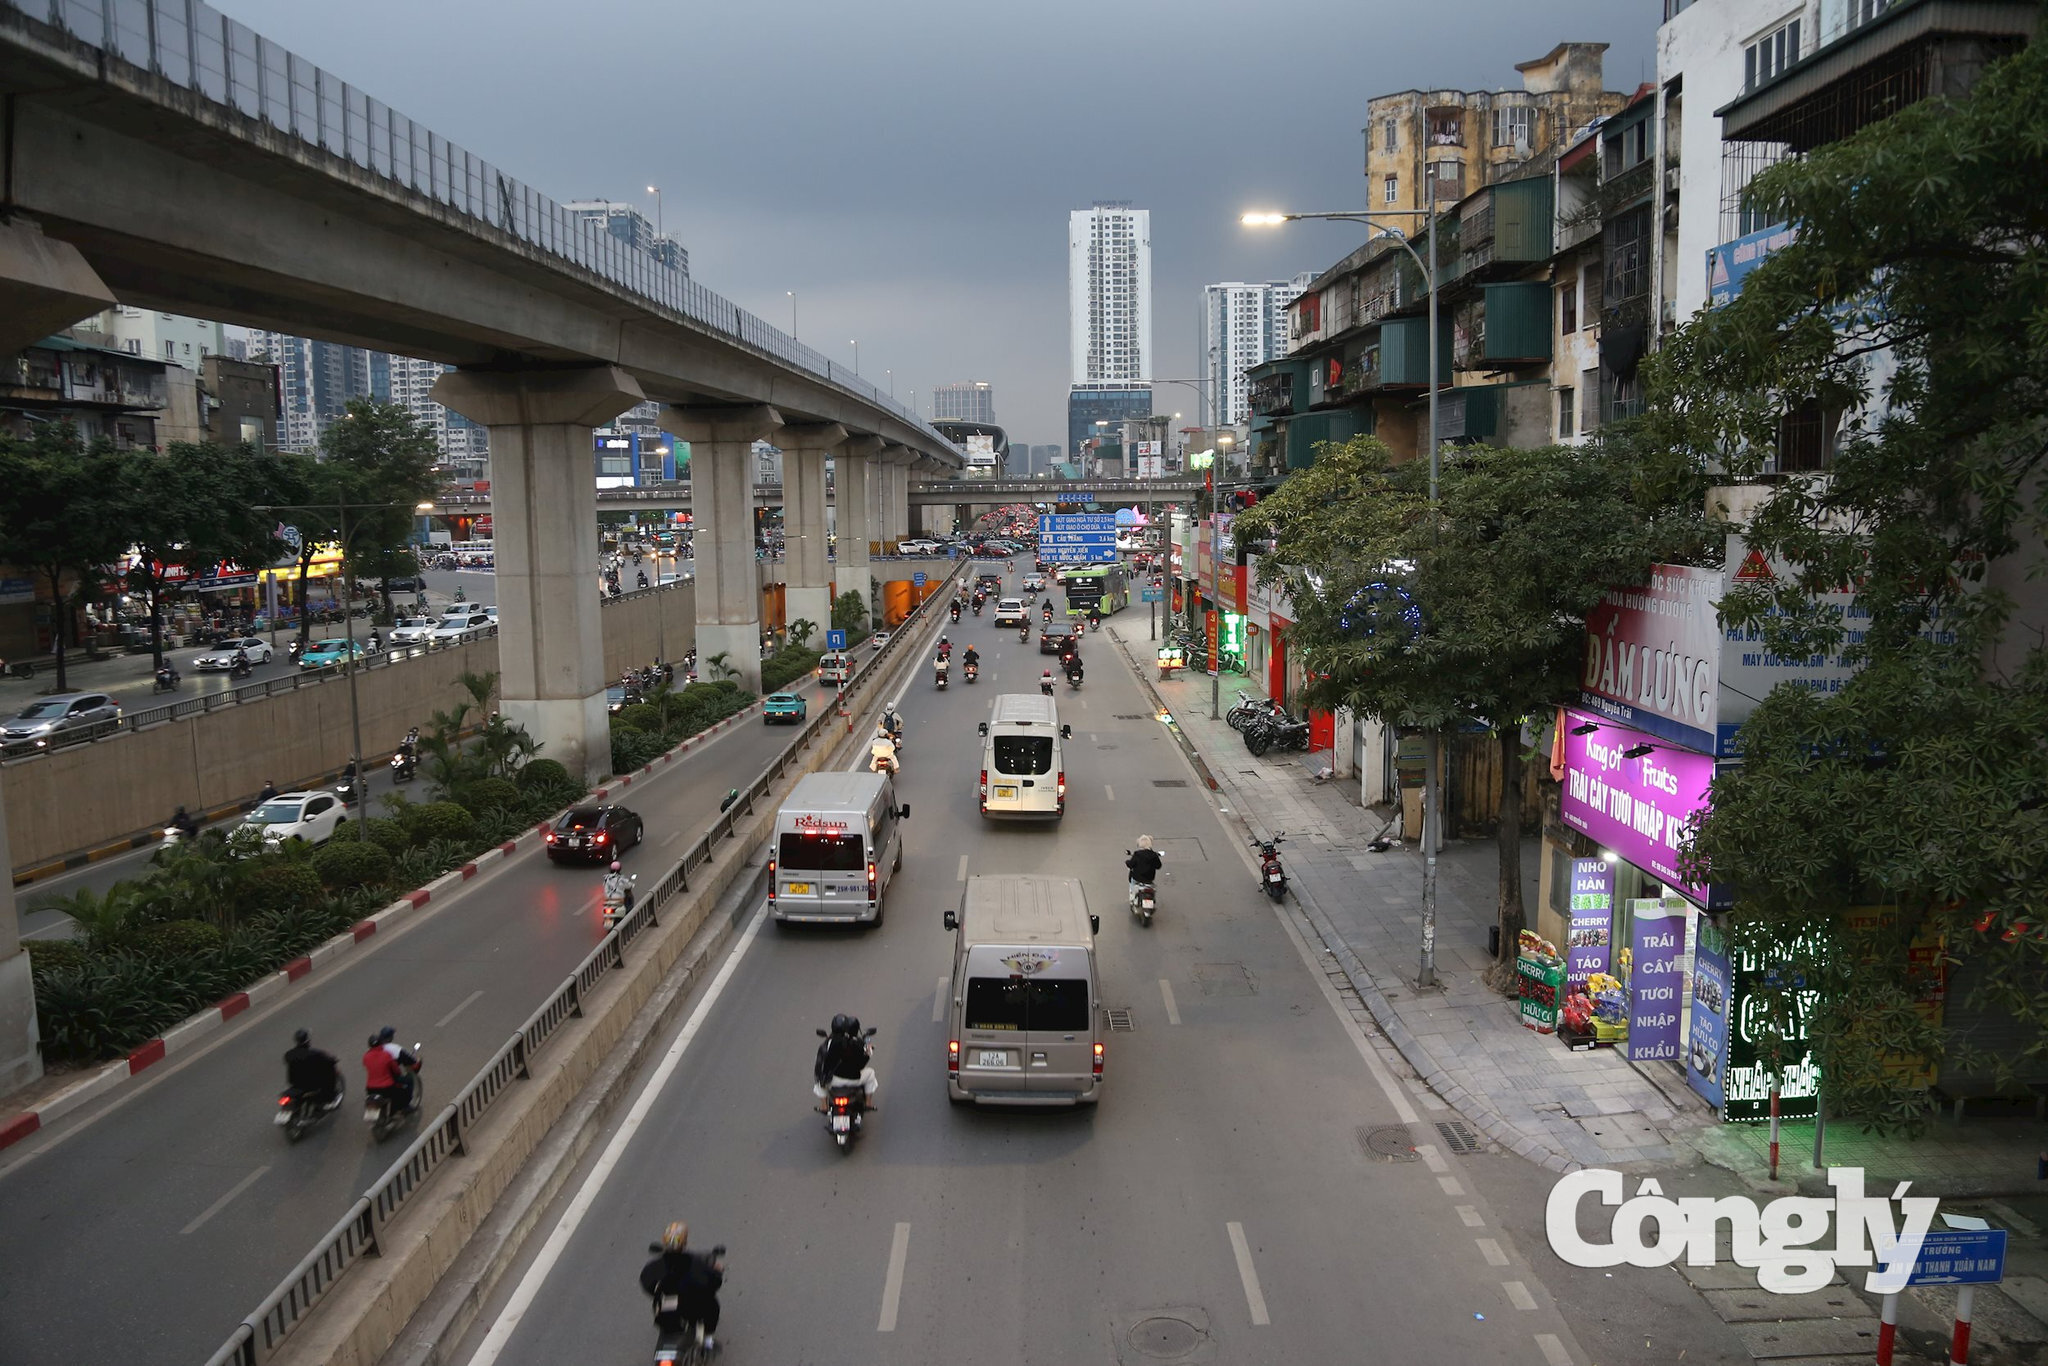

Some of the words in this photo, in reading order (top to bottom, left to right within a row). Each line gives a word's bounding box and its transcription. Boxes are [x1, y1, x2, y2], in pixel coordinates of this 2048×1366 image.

[1667, 573, 1685, 593] SỨC
[1743, 651, 1761, 667] MÁY
[1639, 640, 1712, 725] LƯNG
[1586, 732, 1607, 772] King
[1609, 743, 1623, 770] of
[1643, 757, 1678, 795] Fruits
[1569, 766, 1588, 805] TRÁI
[1590, 775, 1608, 816] CÂY
[1610, 787, 1632, 825] TƯƠI
[1633, 800, 1664, 846] NHẬP
[795, 816, 848, 828] Redsun
[1578, 862, 1607, 873] NHO
[1577, 876, 1605, 890] HÀN
[1571, 917, 1609, 927] CHERRY
[1643, 933, 1674, 948] TRÁI
[1576, 955, 1601, 968] TÁO
[1642, 959, 1675, 974] CÂY
[1698, 956, 1724, 981] CHERRY
[1516, 959, 1547, 982] CHERRY
[1640, 986, 1673, 1001] TƯƠI
[1637, 1012, 1676, 1029] NHẬP
[1699, 1015, 1713, 1033] TÁO
[1634, 1040, 1675, 1060] KHẨU
[1924, 1244, 1961, 1256] TRƯỜNG
[1925, 1260, 1950, 1273] THANH
[1953, 1257, 1974, 1272] XUÂN
[1977, 1259, 1996, 1272] NAM
